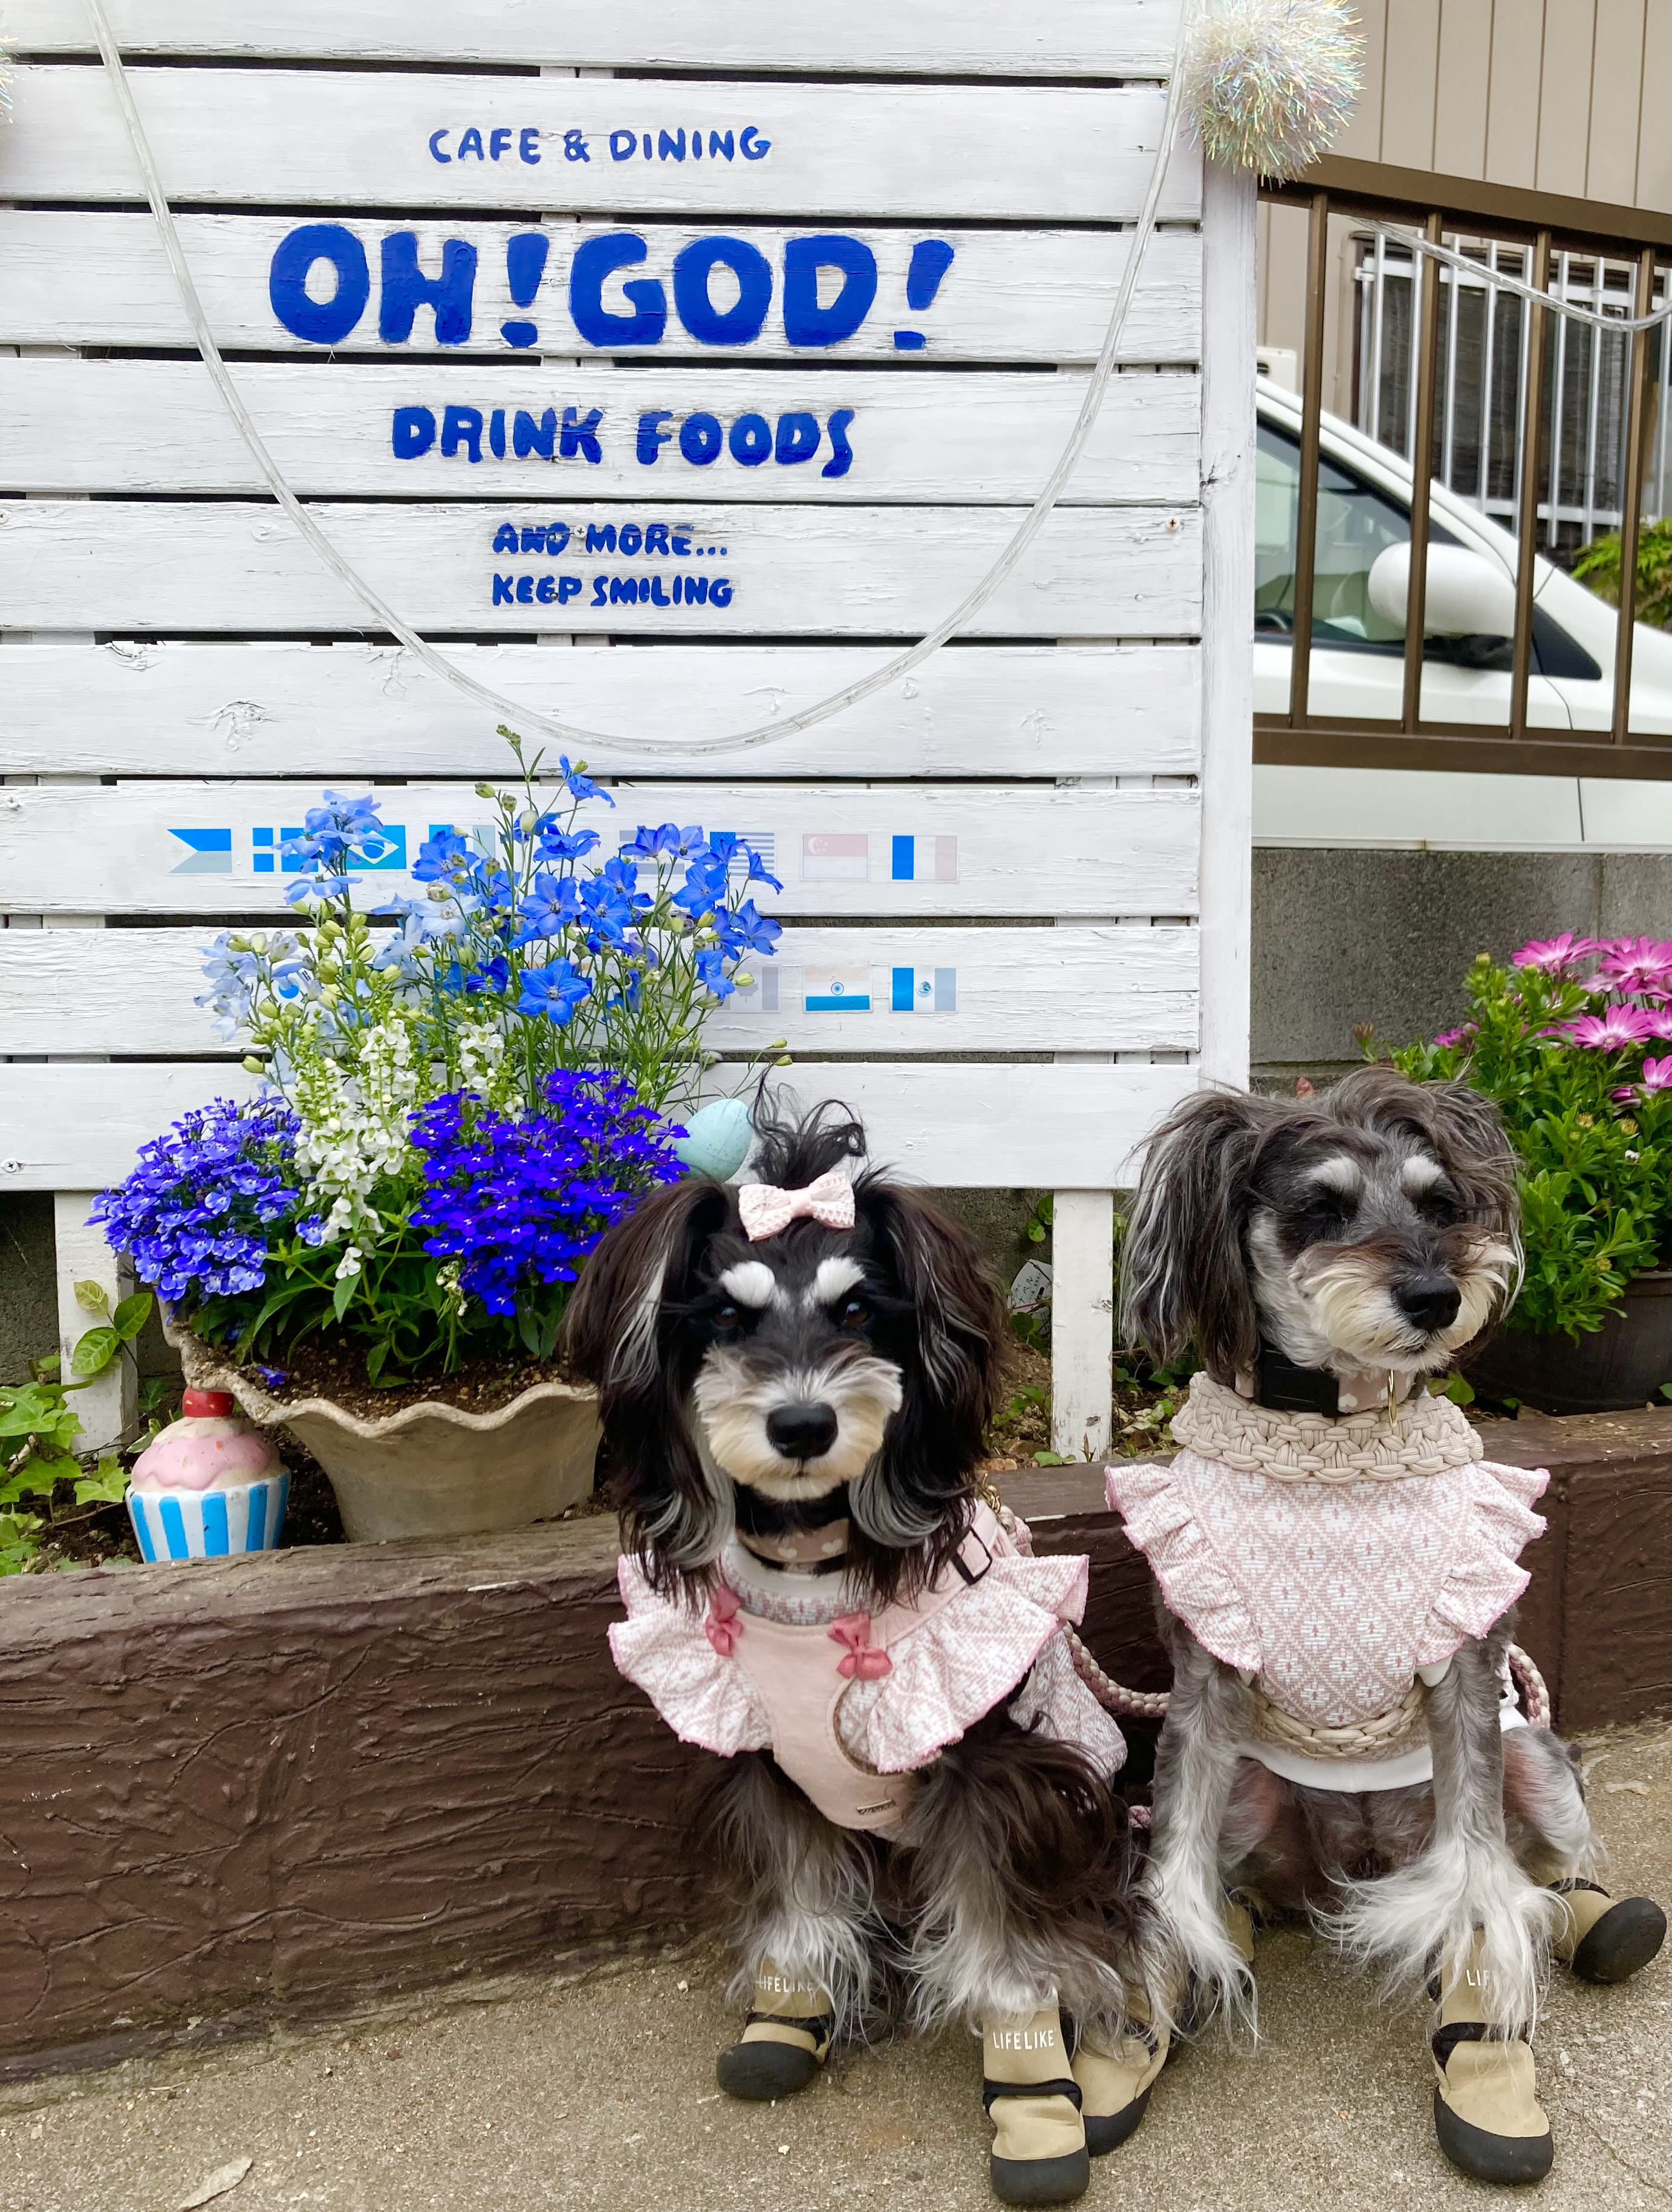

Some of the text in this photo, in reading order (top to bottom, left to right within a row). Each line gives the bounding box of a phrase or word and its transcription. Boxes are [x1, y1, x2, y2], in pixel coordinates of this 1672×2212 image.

[429, 126, 771, 164] CAFE & DINING
[392, 405, 855, 478] DRINK FOODS
[492, 522, 571, 556] AND
[492, 573, 735, 608] KEEP SMILING
[992, 2029, 1055, 2050] LIFELIKE
